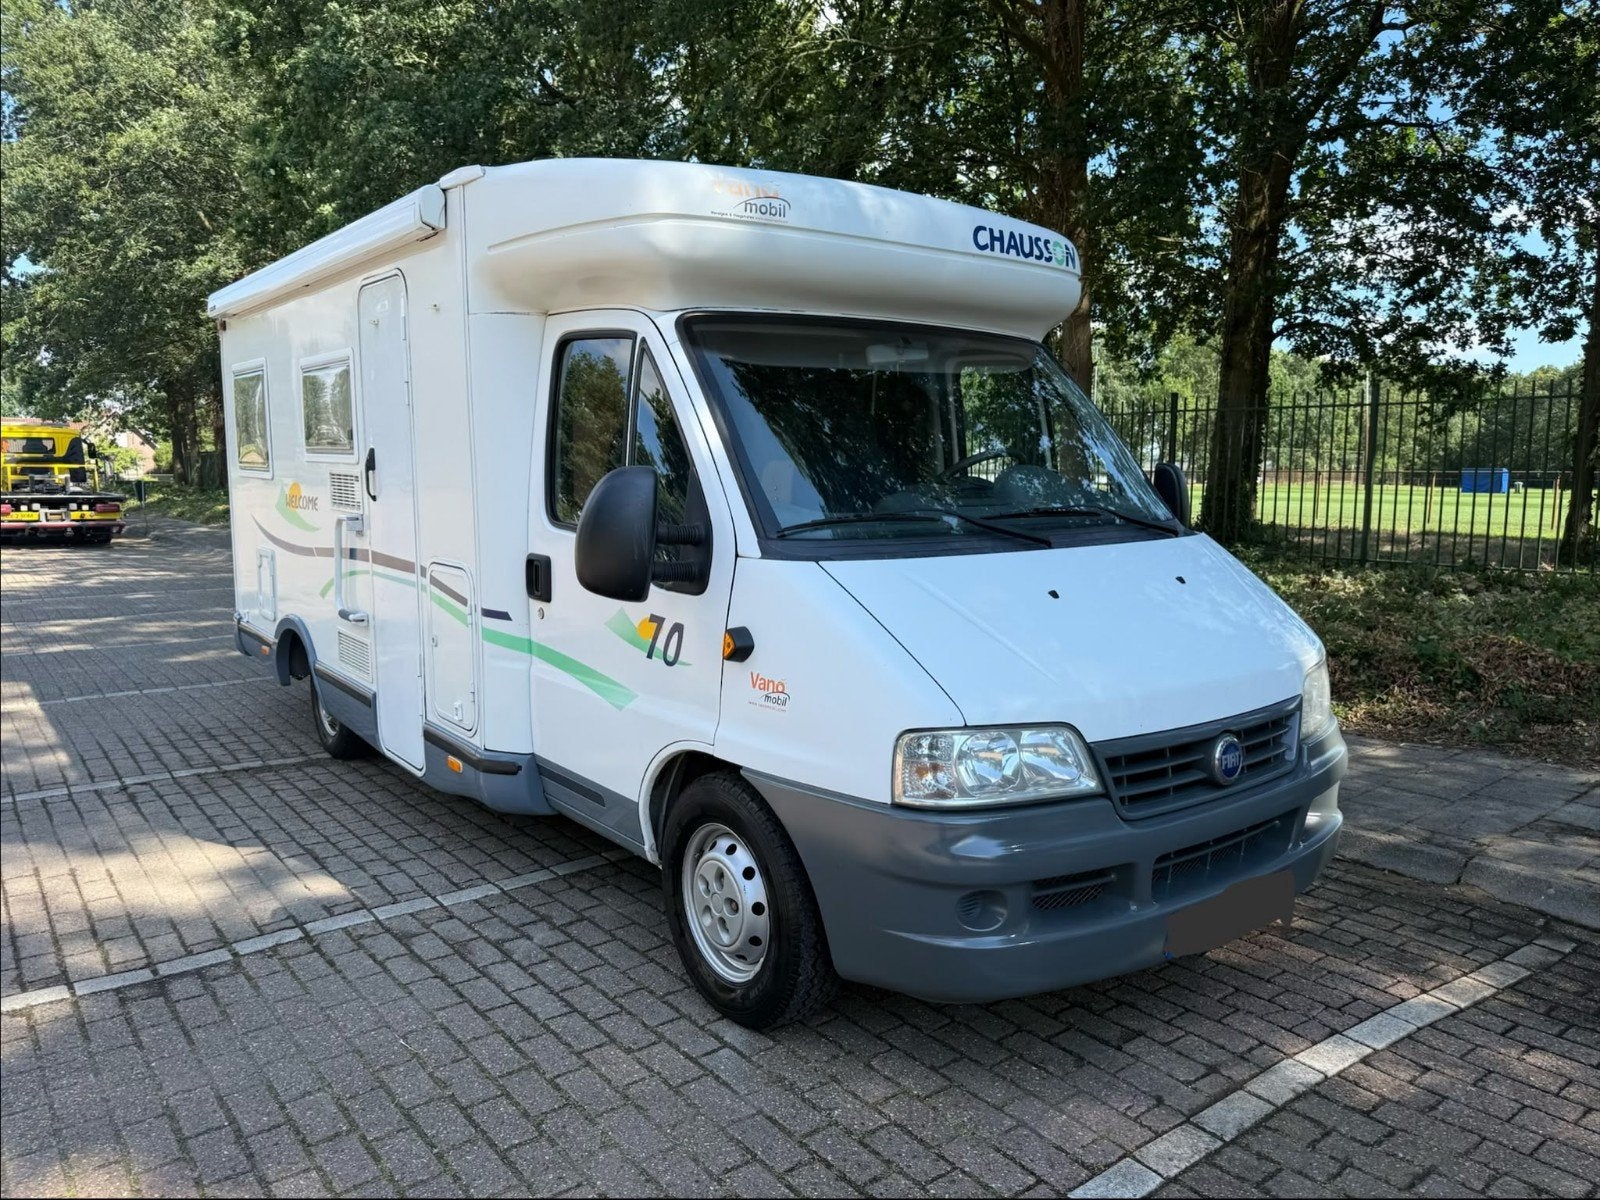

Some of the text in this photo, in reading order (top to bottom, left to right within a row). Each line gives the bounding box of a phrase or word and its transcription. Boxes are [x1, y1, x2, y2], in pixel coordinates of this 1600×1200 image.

[744, 201, 787, 218] mobil
[972, 225, 1077, 270] CHAUSSON
[285, 493, 319, 512] WELCOME
[646, 613, 685, 667] 70
[750, 671, 786, 692] Vano
[763, 694, 788, 707] mobil
[1221, 751, 1241, 770] FIAT
